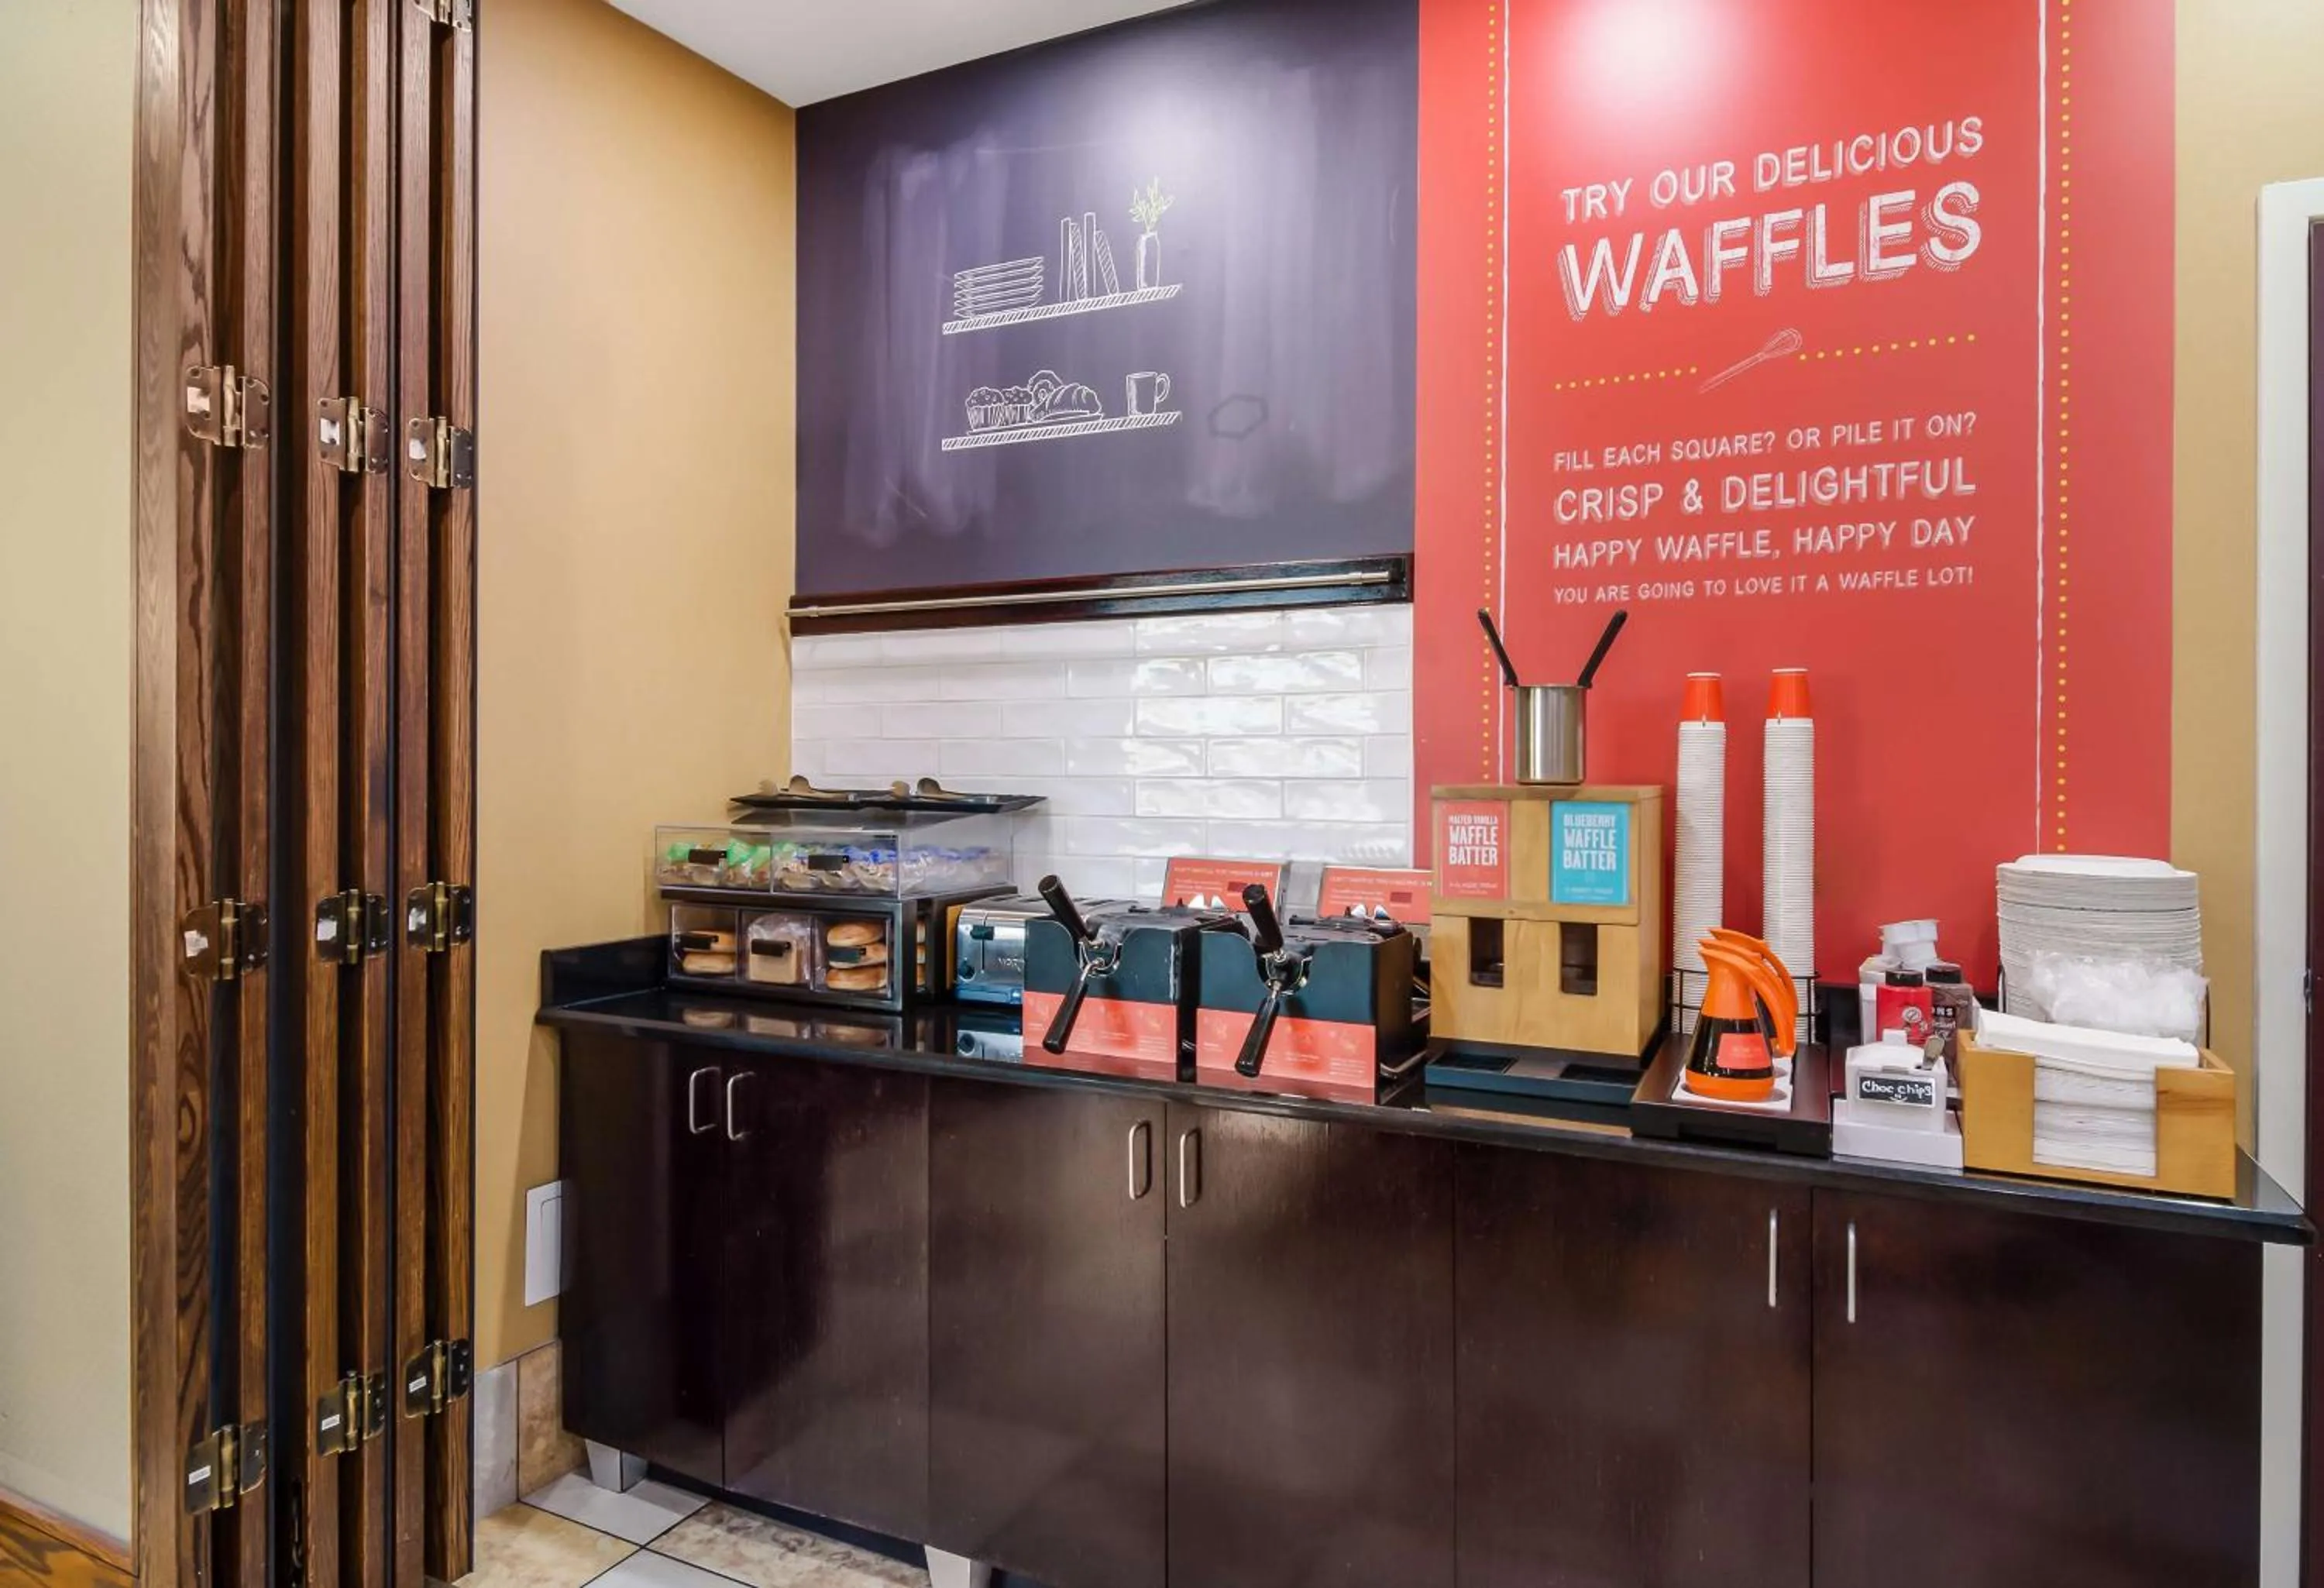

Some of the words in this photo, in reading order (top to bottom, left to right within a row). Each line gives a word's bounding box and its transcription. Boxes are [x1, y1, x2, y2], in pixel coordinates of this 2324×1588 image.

[1561, 177, 1633, 222] TRY
[1649, 160, 1735, 209] OUR
[1754, 116, 1983, 192] DELICIOUS
[1556, 180, 1981, 321] WAFFLES
[1553, 450, 1594, 472] FILL
[1604, 444, 1662, 468] EACH
[1671, 431, 1776, 462] SQUARE?
[1787, 428, 1820, 449] OR
[1831, 421, 1882, 447] PILE
[1892, 417, 1914, 441] IT
[1925, 411, 1976, 438] ON?
[1554, 483, 1663, 524] CRISP
[1683, 479, 1703, 514] &
[1721, 457, 1976, 511] DELIGHTFUL
[1553, 538, 1642, 569] HAPPY
[1656, 530, 1780, 562] WAFFLE,
[1793, 521, 1897, 555] HAPPY
[1910, 516, 1976, 548] DAY
[1554, 586, 1588, 604] YOU
[1595, 584, 1630, 602] ARE
[1638, 580, 1694, 600] GOING
[1704, 579, 1727, 596] TO
[1734, 576, 1782, 596] LOVE
[1790, 575, 1807, 593] IT
[1816, 575, 1829, 591] A
[1839, 569, 1918, 589] WAFFLE
[1927, 566, 1973, 586] LOT!
[1449, 826, 1498, 845] WAFFLE
[1563, 813, 1616, 828] BLUEBERRY
[1563, 828, 1618, 850] WAFFLE
[1449, 846, 1498, 866] BATTER
[1563, 851, 1617, 871] BATTER
[1862, 1081, 1894, 1093] Choc
[1897, 1084, 1931, 1098] chips
